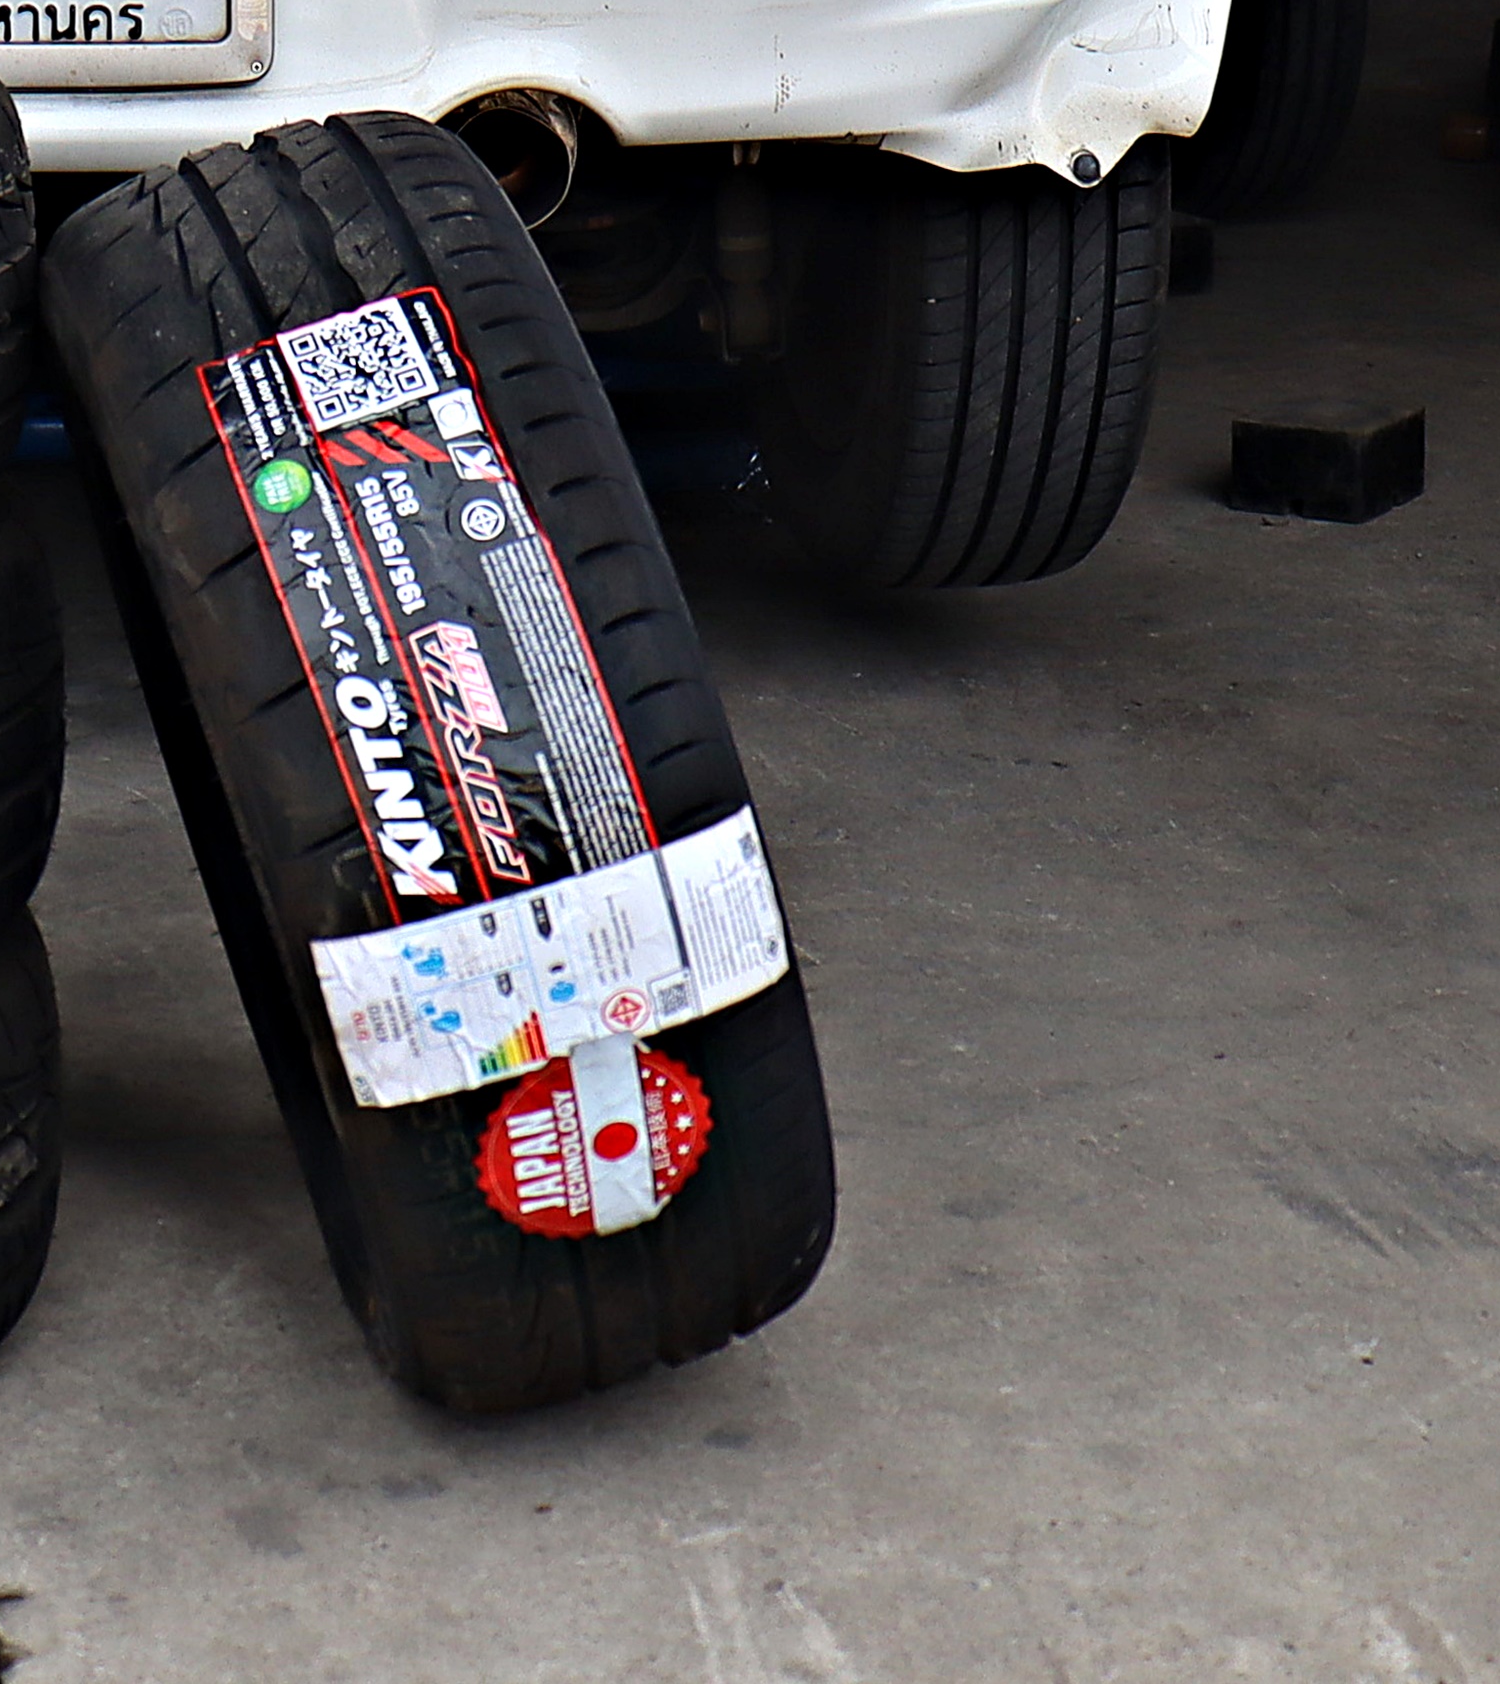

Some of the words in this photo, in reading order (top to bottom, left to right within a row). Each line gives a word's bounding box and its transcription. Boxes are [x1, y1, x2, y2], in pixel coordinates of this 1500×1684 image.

[227, 355, 260, 417] WARRANTY
[248, 413, 271, 453] YEARS
[354, 476, 427, 616] 195/55R15
[382, 469, 420, 518] 85V
[290, 527, 360, 674] キントータイヤ
[364, 614, 391, 667] Through
[378, 678, 409, 736] Tyres
[437, 619, 510, 734] 001
[336, 675, 460, 900] KINTO
[408, 620, 535, 885] FORZA
[505, 1107, 566, 1215] JAPAN
[551, 1088, 592, 1217] TECHNOLOGY
